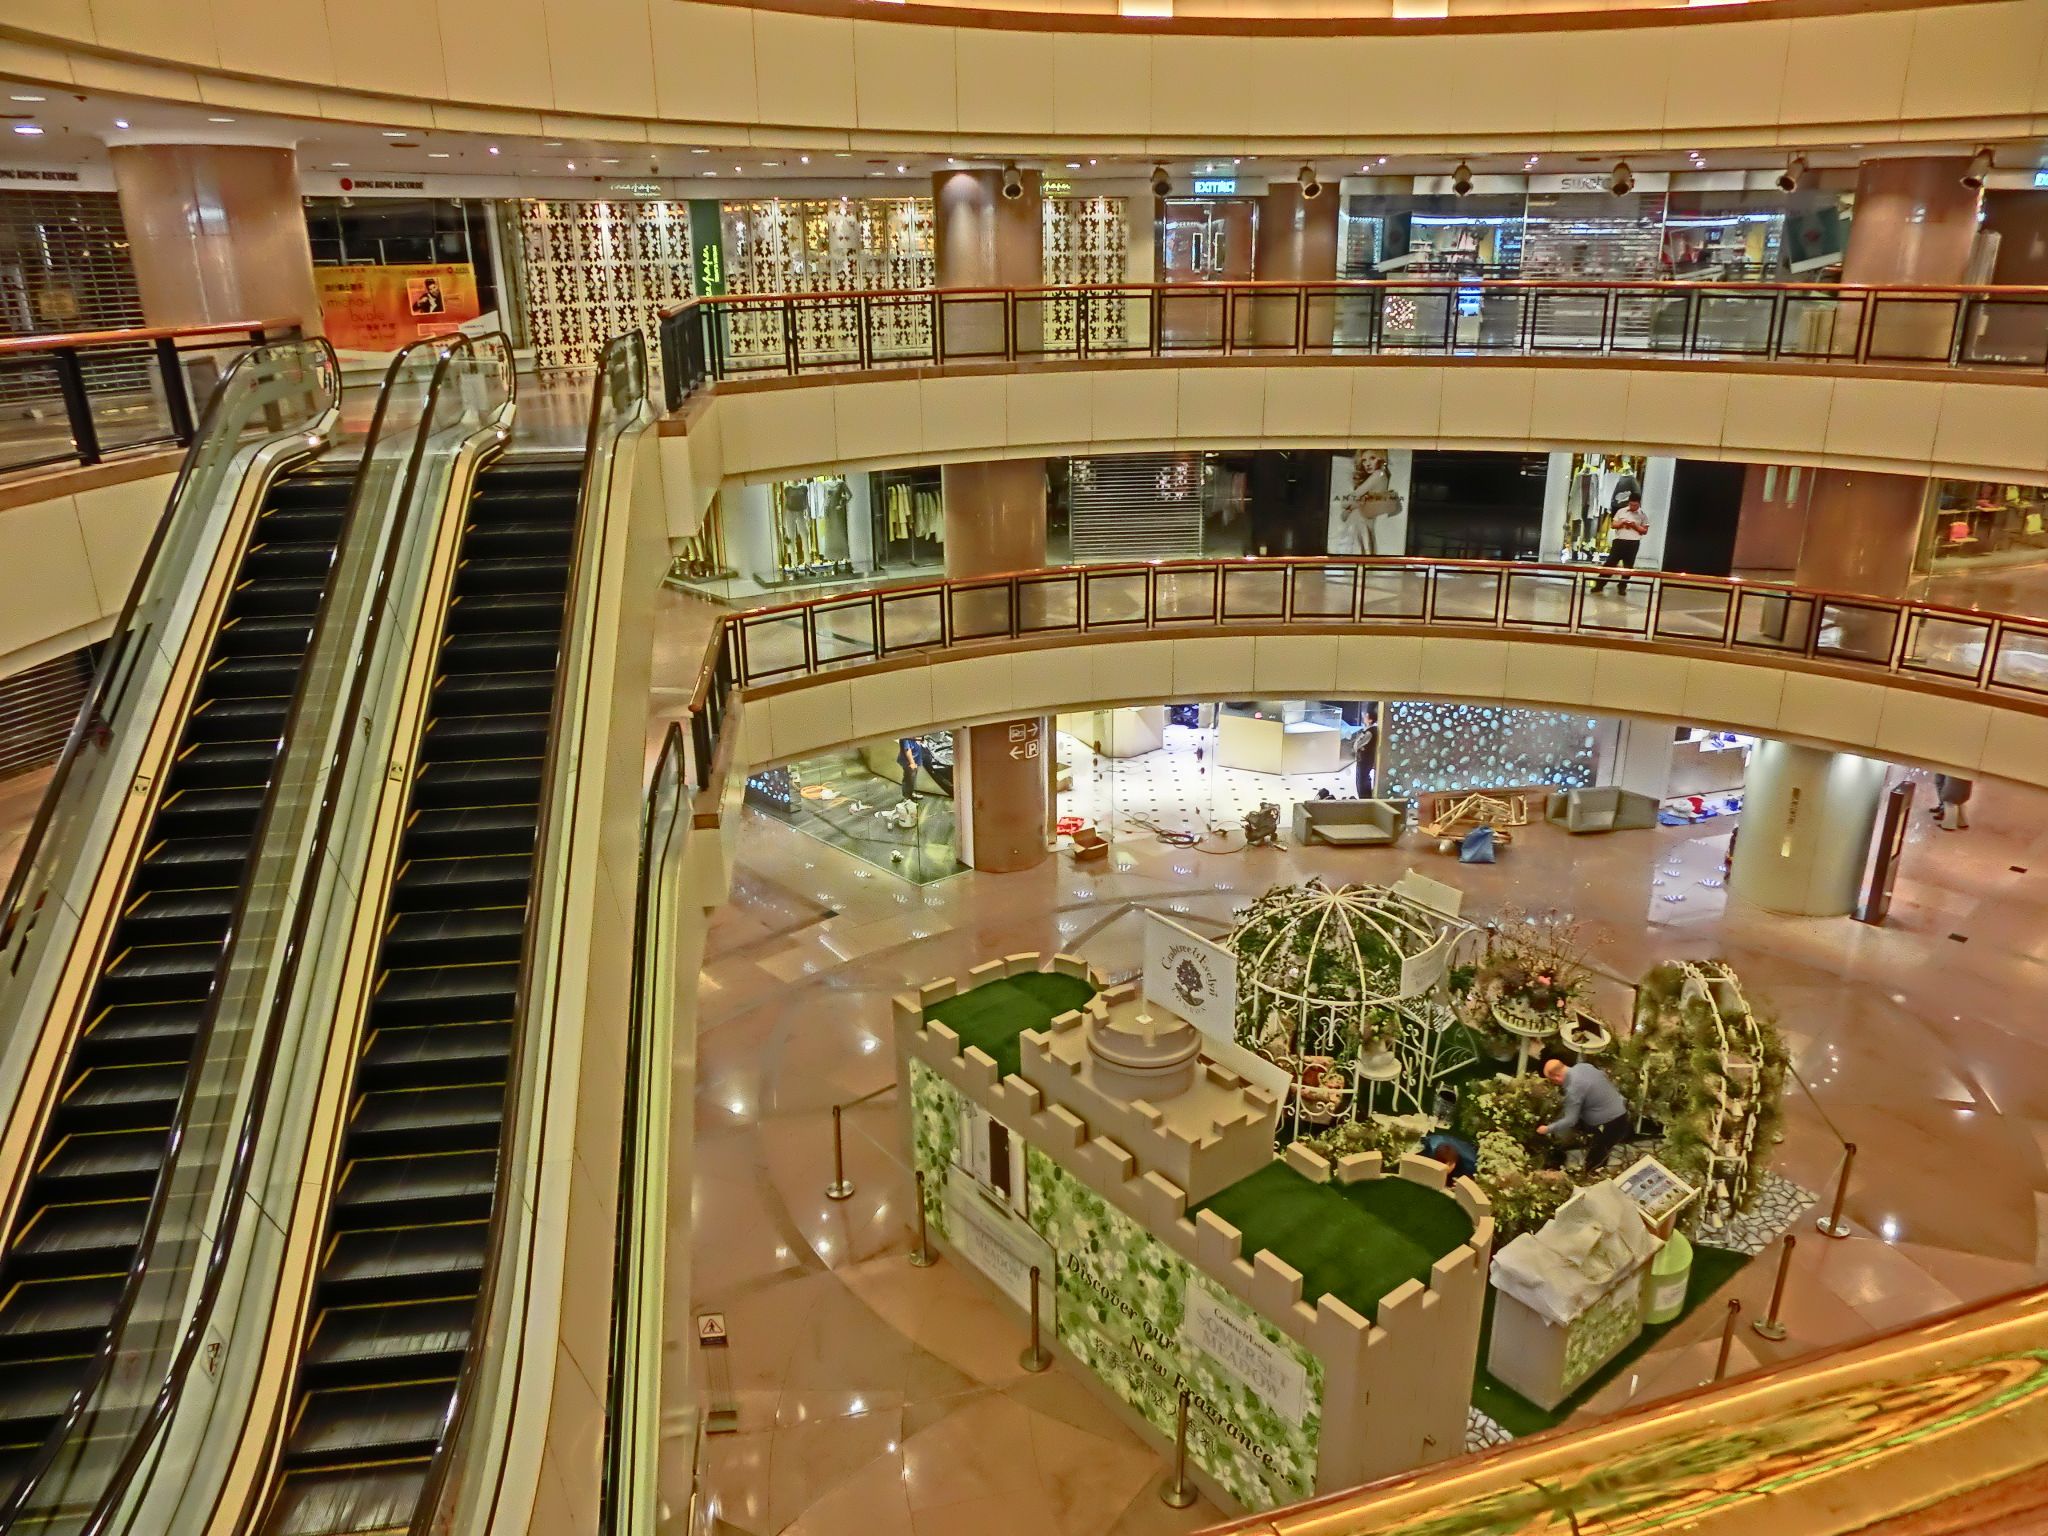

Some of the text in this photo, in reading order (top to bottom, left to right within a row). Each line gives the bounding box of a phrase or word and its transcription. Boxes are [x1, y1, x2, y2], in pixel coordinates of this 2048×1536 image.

[1561, 176, 1616, 190] swatc
[1066, 1253, 1138, 1320] Discover
[1129, 1334, 1168, 1378] New
